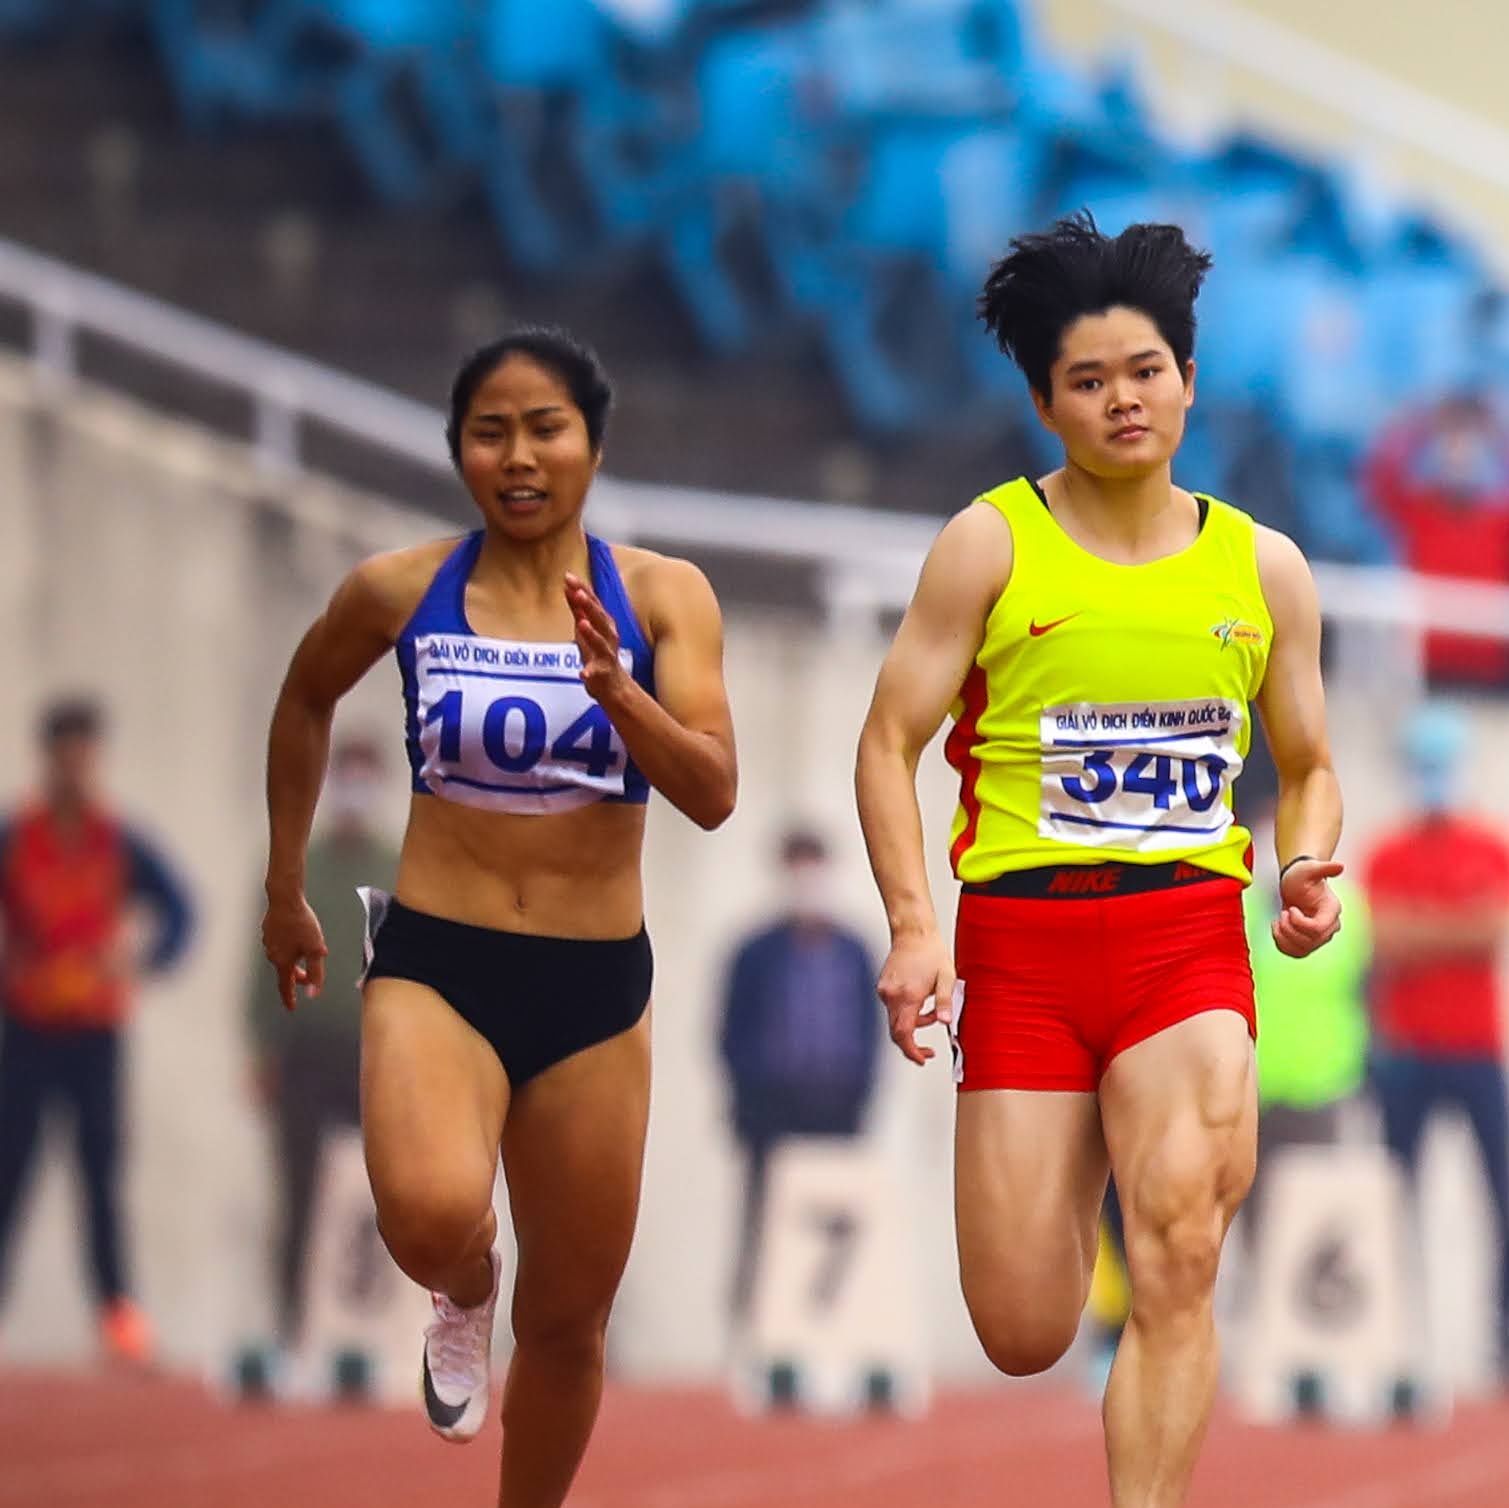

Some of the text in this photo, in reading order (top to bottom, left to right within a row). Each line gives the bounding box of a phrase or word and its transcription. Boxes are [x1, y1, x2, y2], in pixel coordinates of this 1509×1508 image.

[425, 690, 619, 777] 104
[1159, 710, 1185, 727] KINH
[1060, 750, 1228, 813] 340
[1048, 867, 1124, 894] NIKE
[803, 1203, 868, 1322] 7
